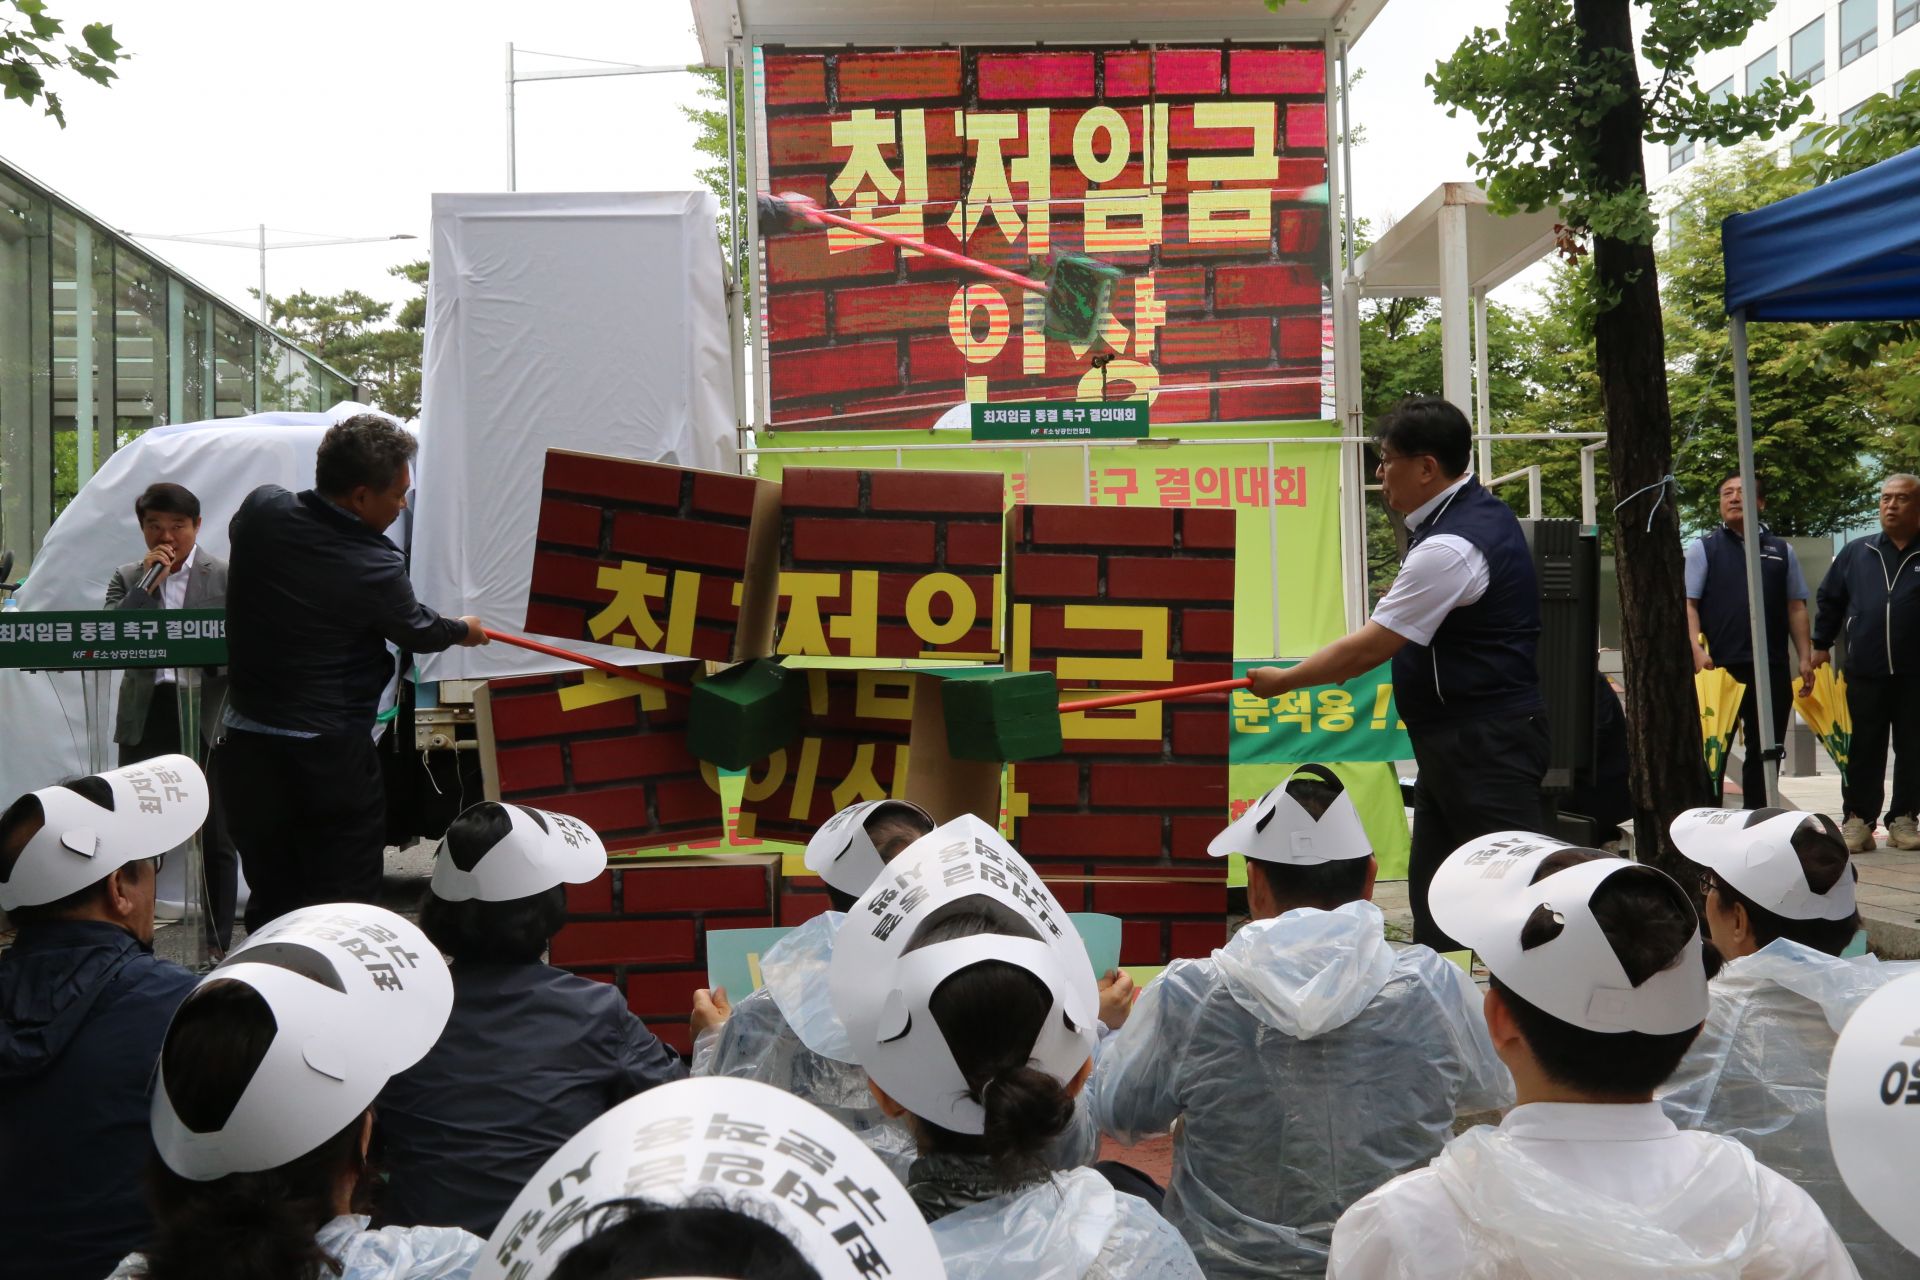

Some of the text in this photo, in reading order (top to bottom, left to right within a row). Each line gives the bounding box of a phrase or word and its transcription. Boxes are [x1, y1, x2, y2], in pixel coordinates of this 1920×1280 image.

[827, 101, 1279, 256] 최저임금
[983, 407, 1137, 423] 최저임금 동결 촉구 결의대회
[1090, 466, 1307, 508] 구 결의대회
[0, 621, 73, 643] 최저임금
[80, 621, 116, 642] 동결
[123, 620, 159, 641] 촉구
[867, 836, 1055, 917] 구분적용 시행
[871, 861, 1064, 942] 최저임금 동결
[632, 1112, 889, 1227] 구분적용
